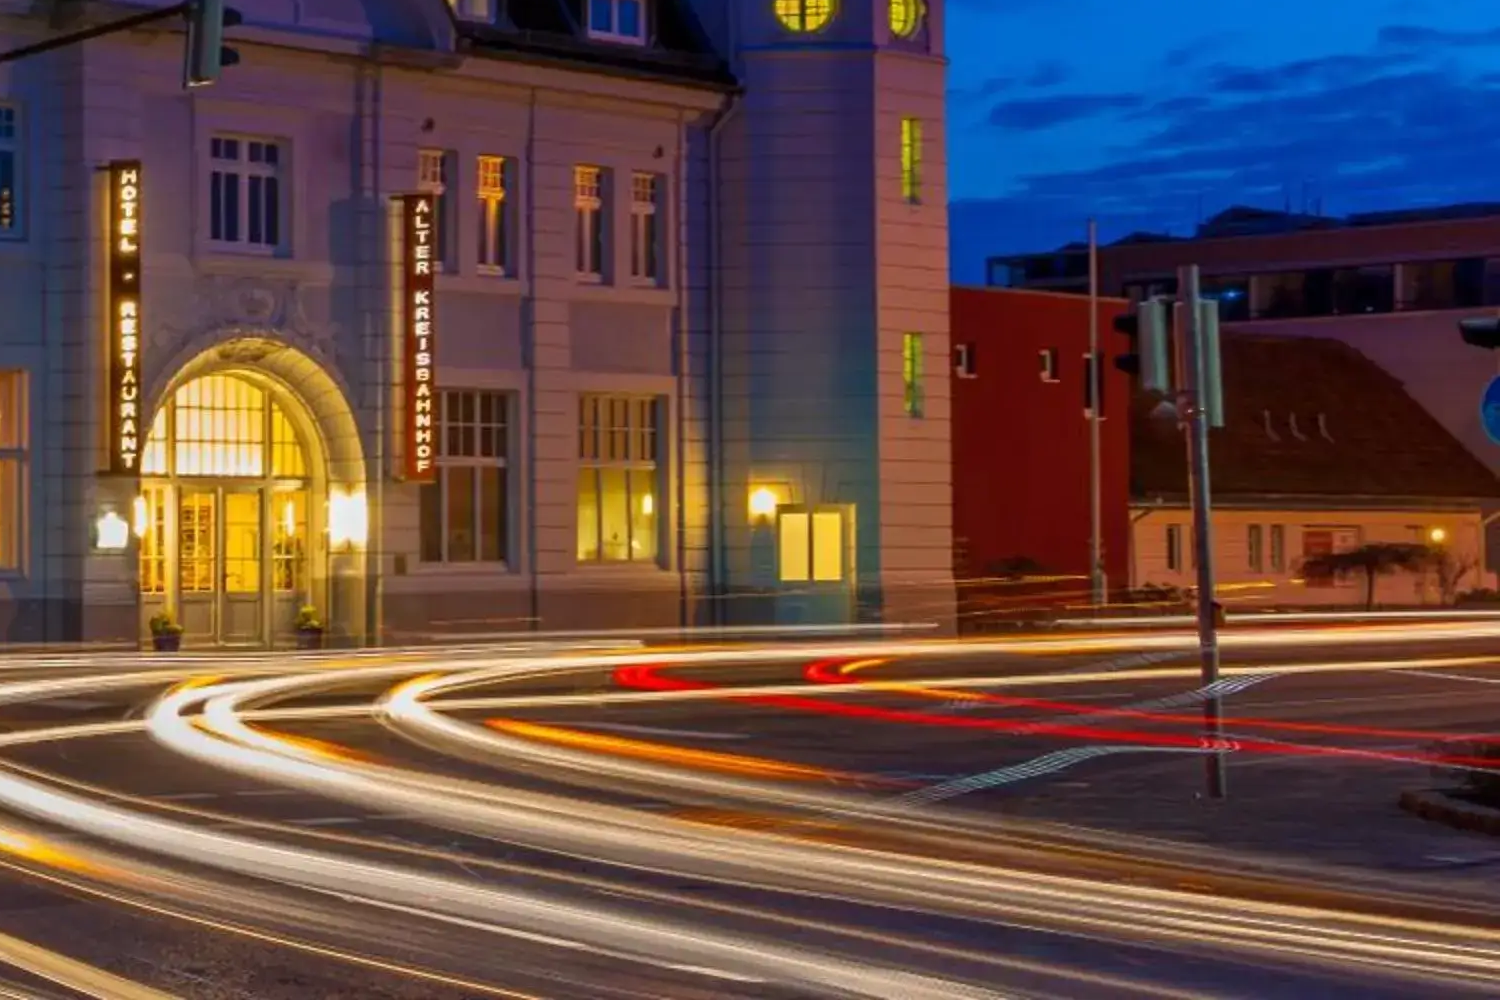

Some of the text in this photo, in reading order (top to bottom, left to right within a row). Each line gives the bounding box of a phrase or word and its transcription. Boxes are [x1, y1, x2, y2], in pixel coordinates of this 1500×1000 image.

[120, 169, 138, 253] HOTEL
[120, 301, 138, 469] RESTAURANT
[415, 199, 431, 474] ALTER KREISBAHNHOF
